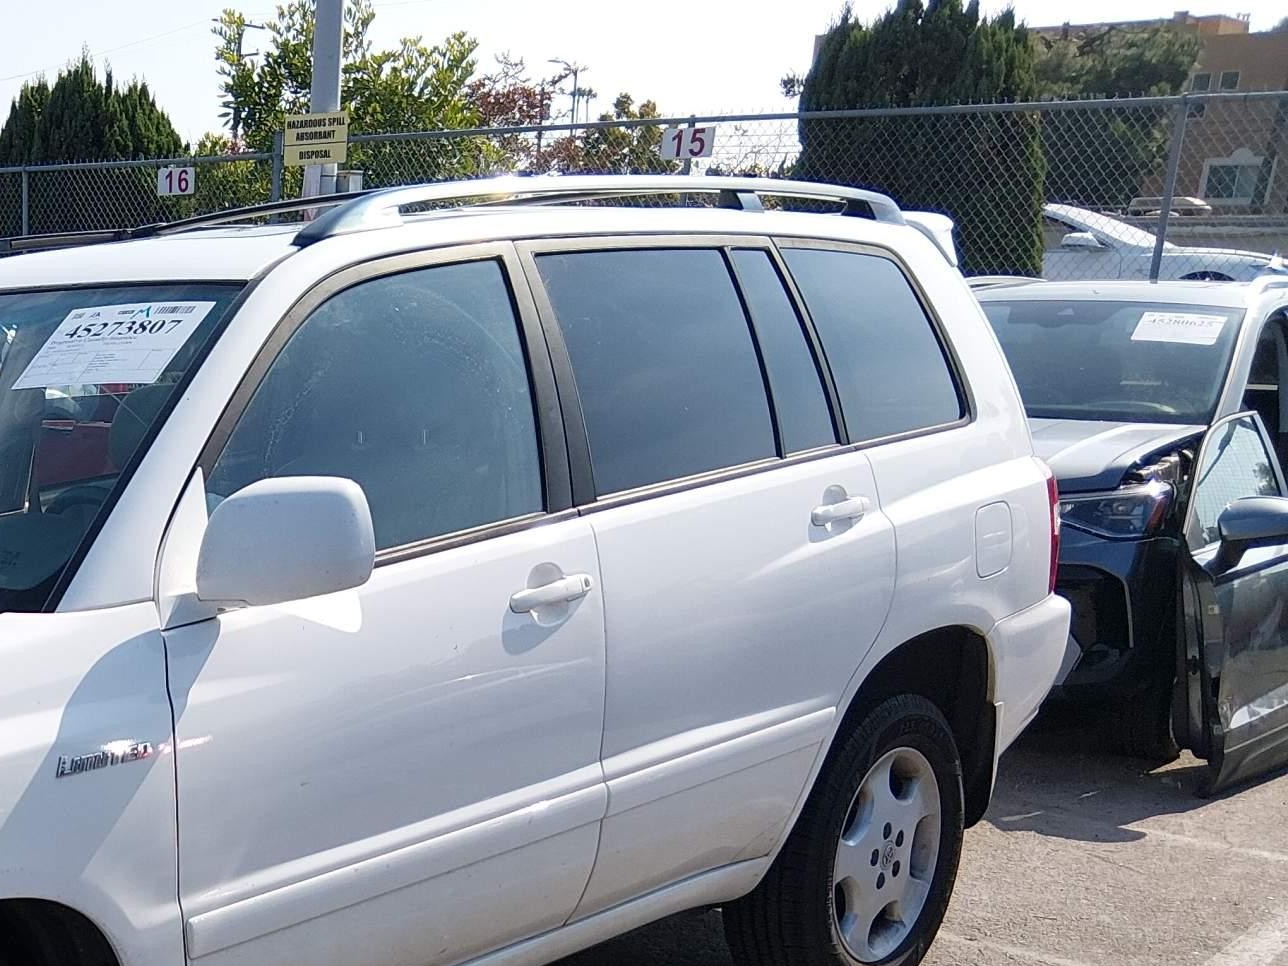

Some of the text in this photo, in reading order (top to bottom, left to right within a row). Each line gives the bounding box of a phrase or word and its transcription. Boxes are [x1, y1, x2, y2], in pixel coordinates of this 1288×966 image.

[287, 116, 346, 129] HAZARDOUS SPILL
[295, 130, 336, 141] ABSORBANT
[671, 128, 706, 157] 15
[299, 149, 331, 160] DISPOSAL
[165, 169, 189, 193] 16
[65, 319, 183, 339] 45273807
